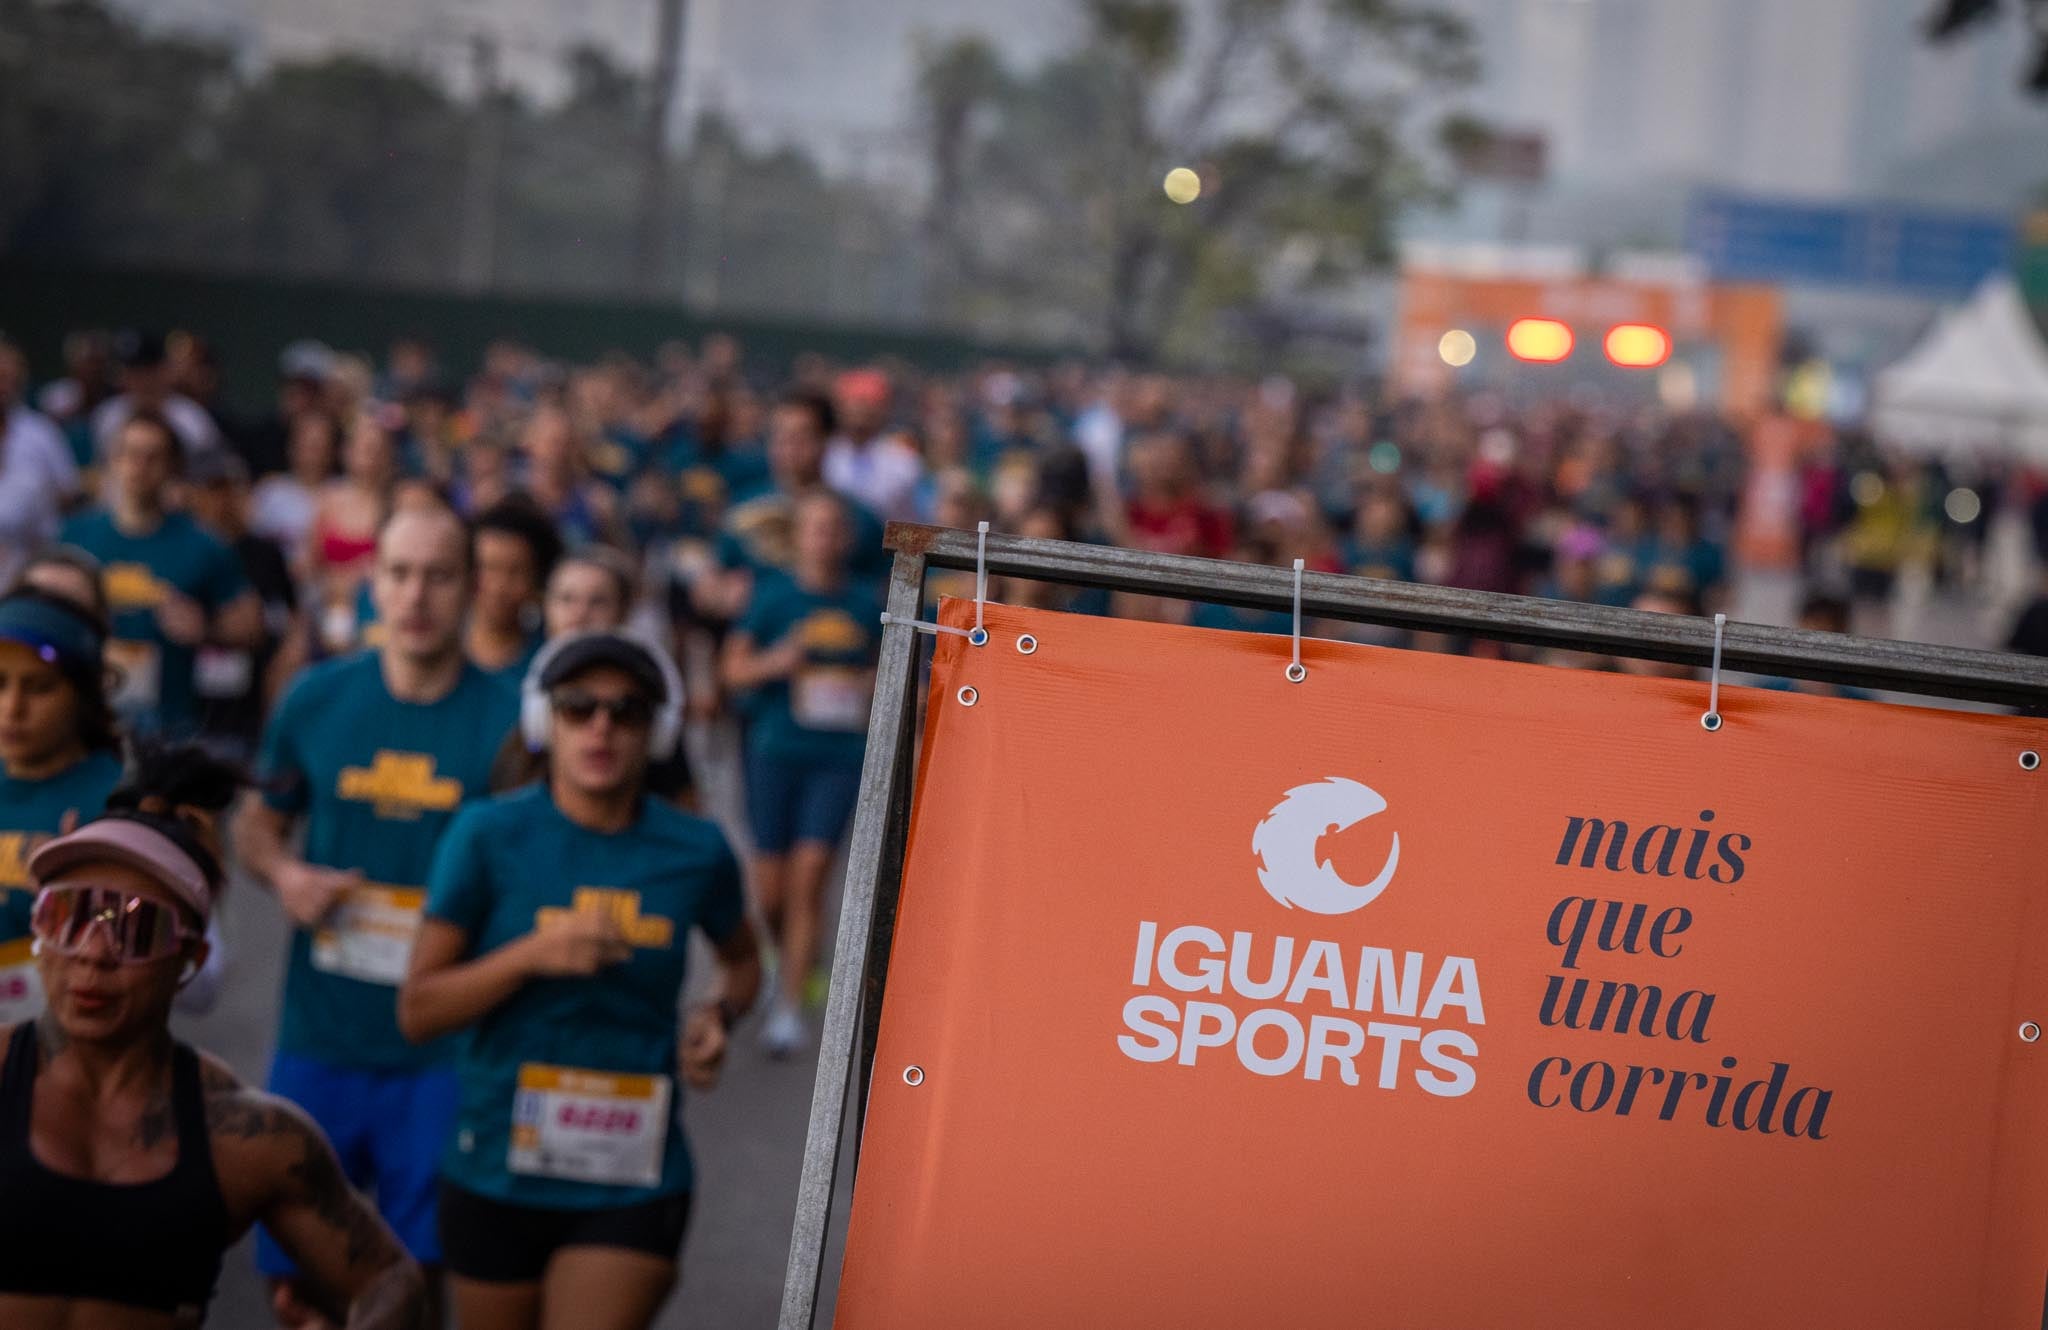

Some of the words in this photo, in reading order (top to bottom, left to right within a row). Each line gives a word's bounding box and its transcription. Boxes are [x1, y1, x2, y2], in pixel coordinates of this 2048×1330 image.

[1555, 809, 1752, 884] mais
[1131, 920, 1486, 1025] IGUANA
[1546, 896, 1693, 969] que
[1116, 994, 1479, 1097] SPORTS
[1538, 975, 1716, 1044] uma
[1527, 1056, 1834, 1141] corrida
